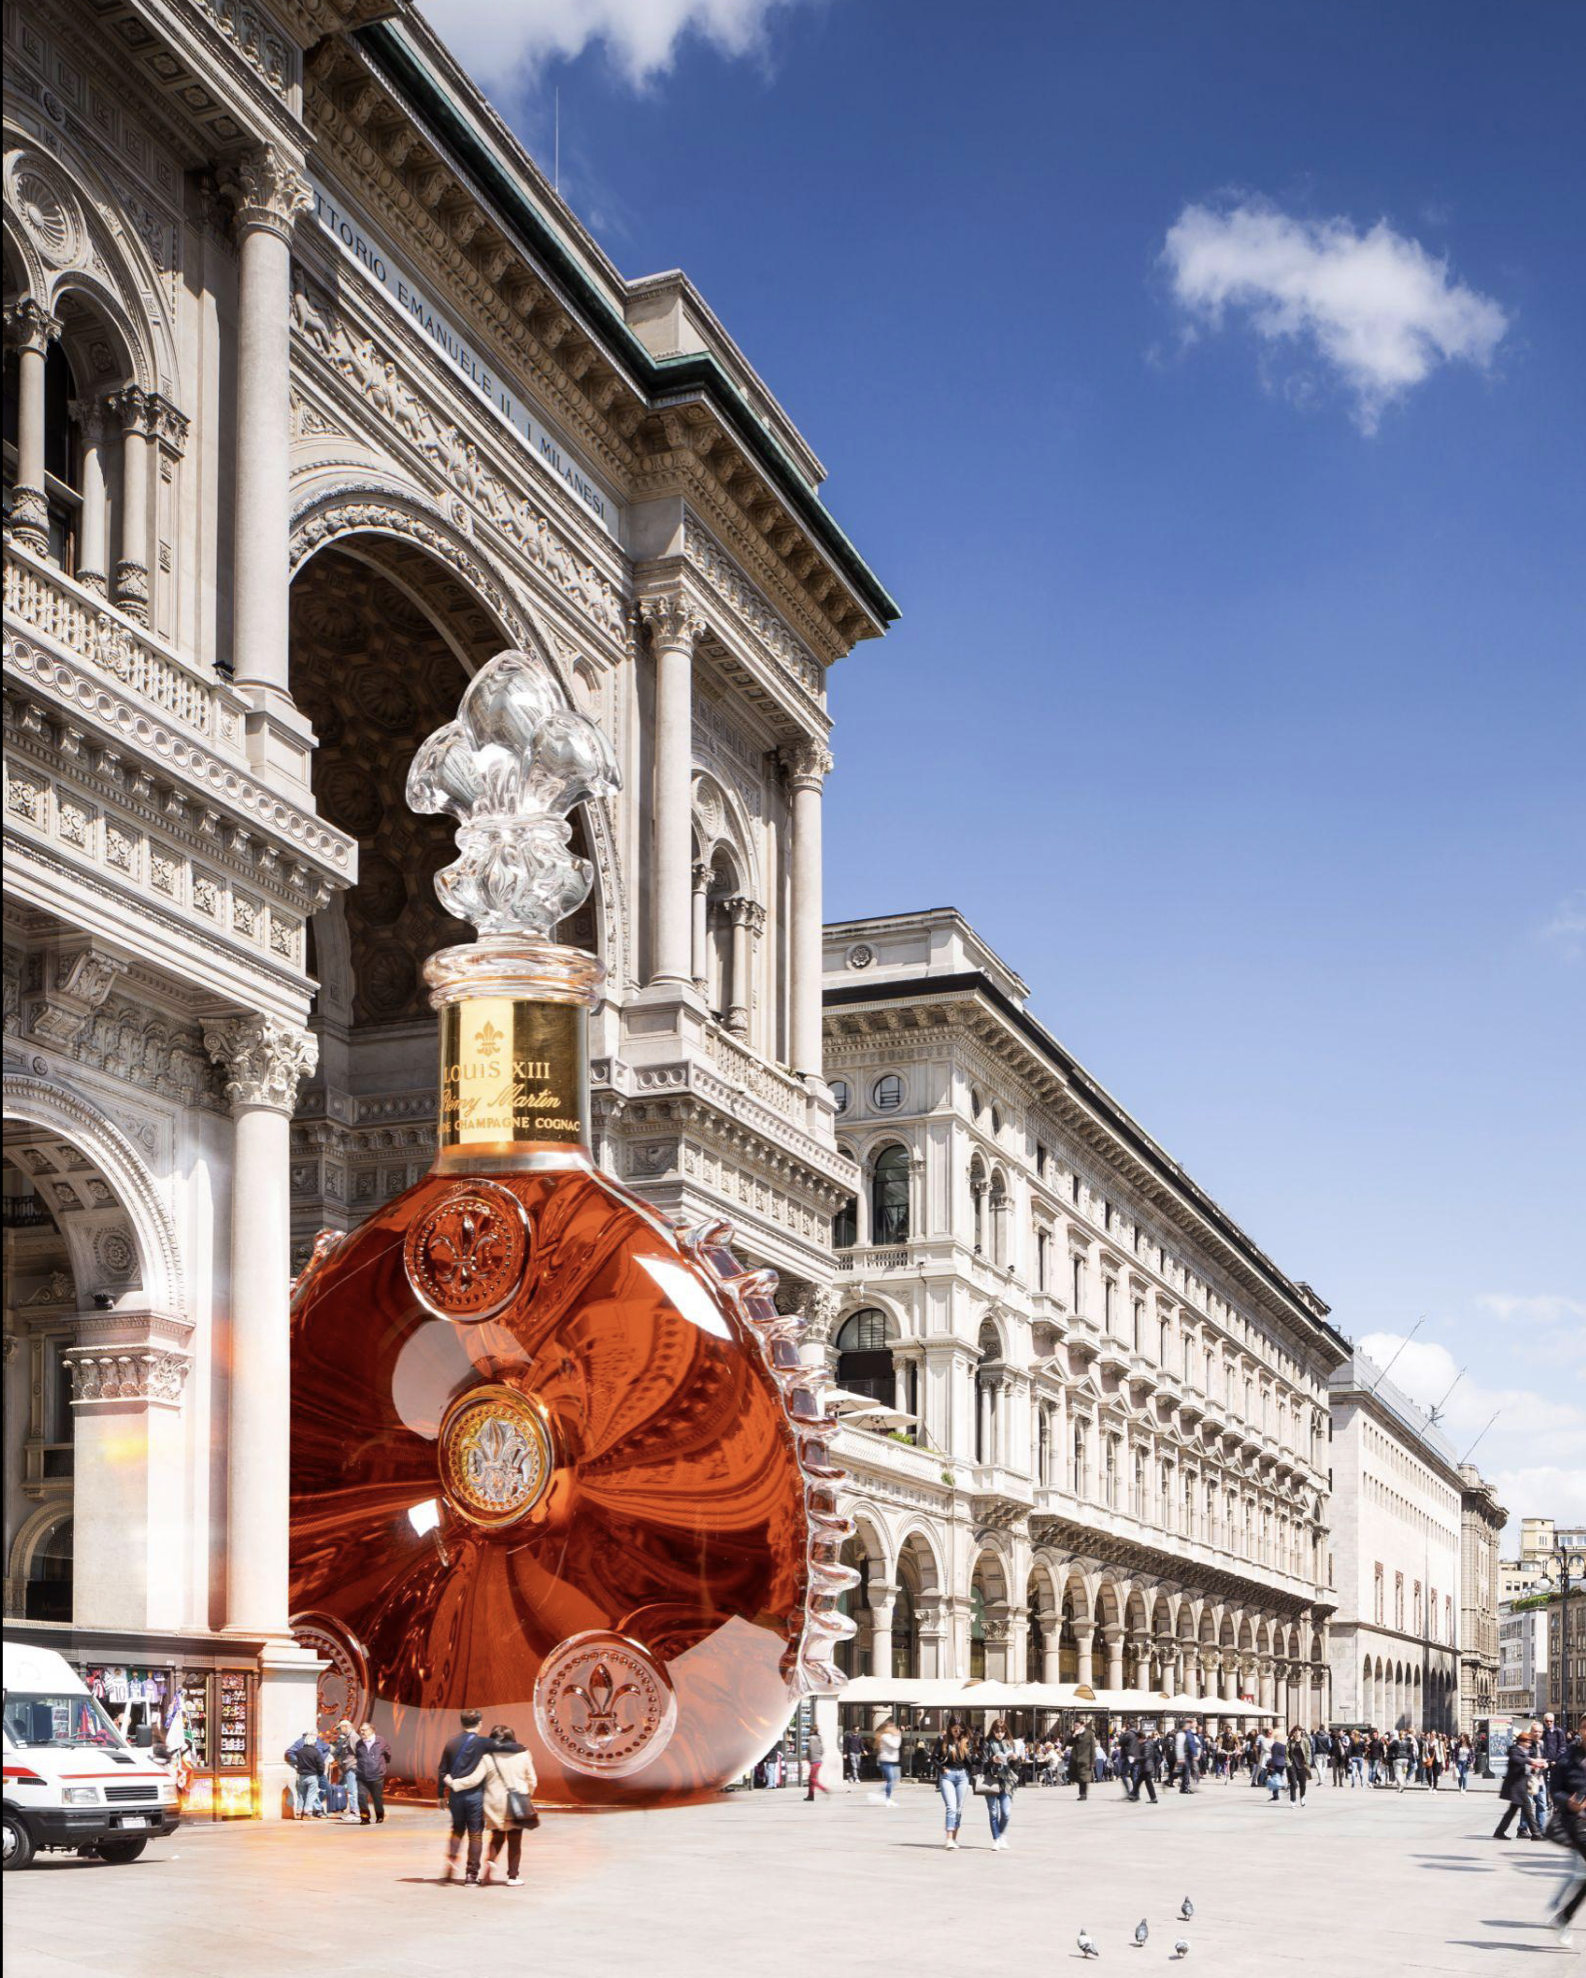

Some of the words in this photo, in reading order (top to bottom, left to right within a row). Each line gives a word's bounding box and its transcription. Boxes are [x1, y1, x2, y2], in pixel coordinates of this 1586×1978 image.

[314, 190, 386, 282] TTORIO
[398, 280, 492, 399] EMANUELE
[540, 437, 604, 520] MILANESI
[444, 1061, 501, 1083] LOUIS
[510, 1062, 551, 1079] XIII
[487, 1083, 561, 1108] Martin
[455, 1117, 530, 1131] CHAMPAGNE
[535, 1117, 581, 1132] COGNAC
[115, 1686, 126, 1701] 10
